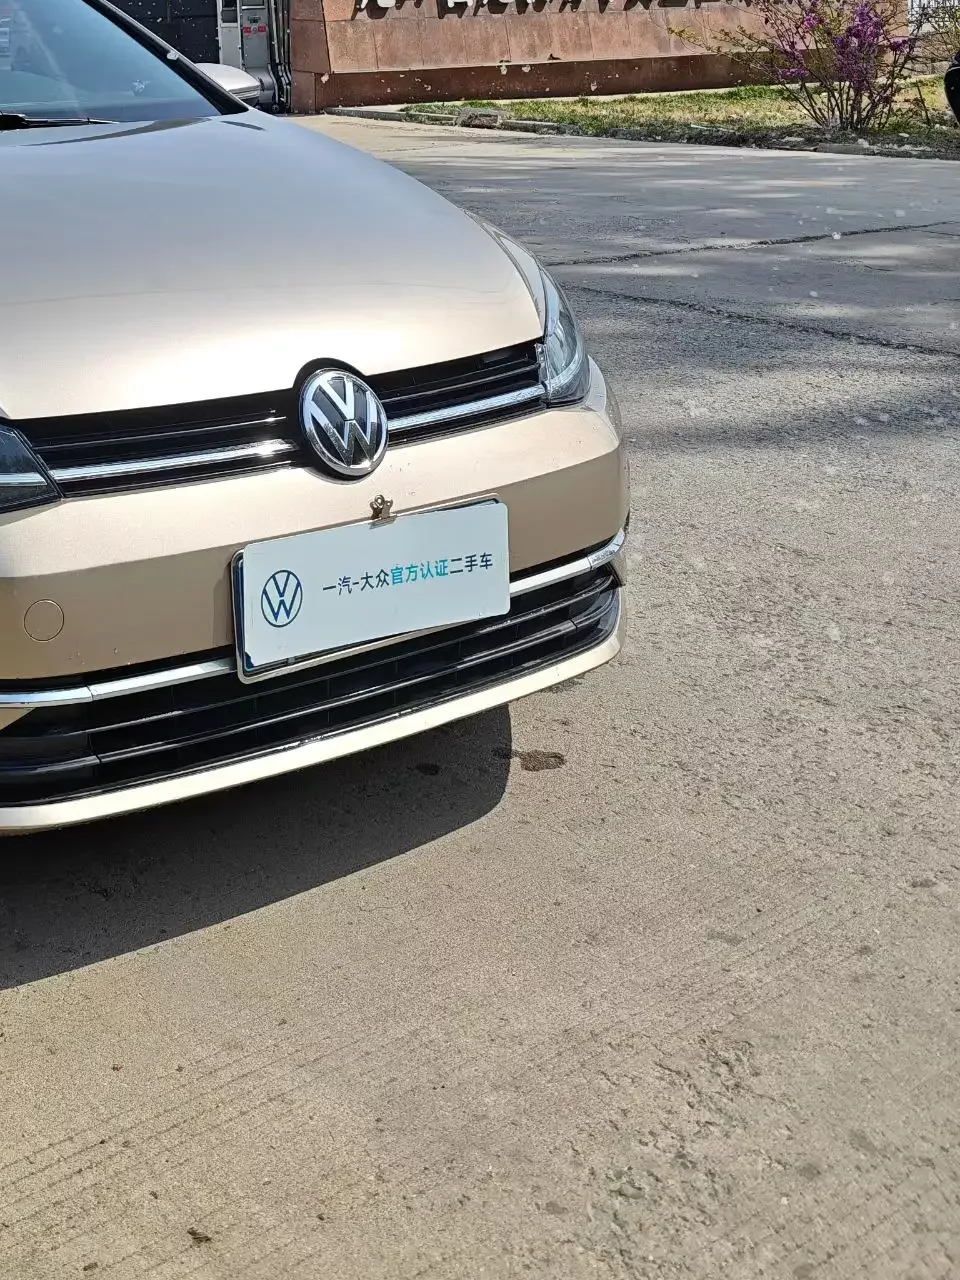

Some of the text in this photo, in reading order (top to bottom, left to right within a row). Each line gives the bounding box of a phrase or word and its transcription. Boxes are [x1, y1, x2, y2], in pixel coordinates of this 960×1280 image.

[261, 570, 302, 627] VW
[322, 552, 493, 595] 一汽-大众官方认证二手车
